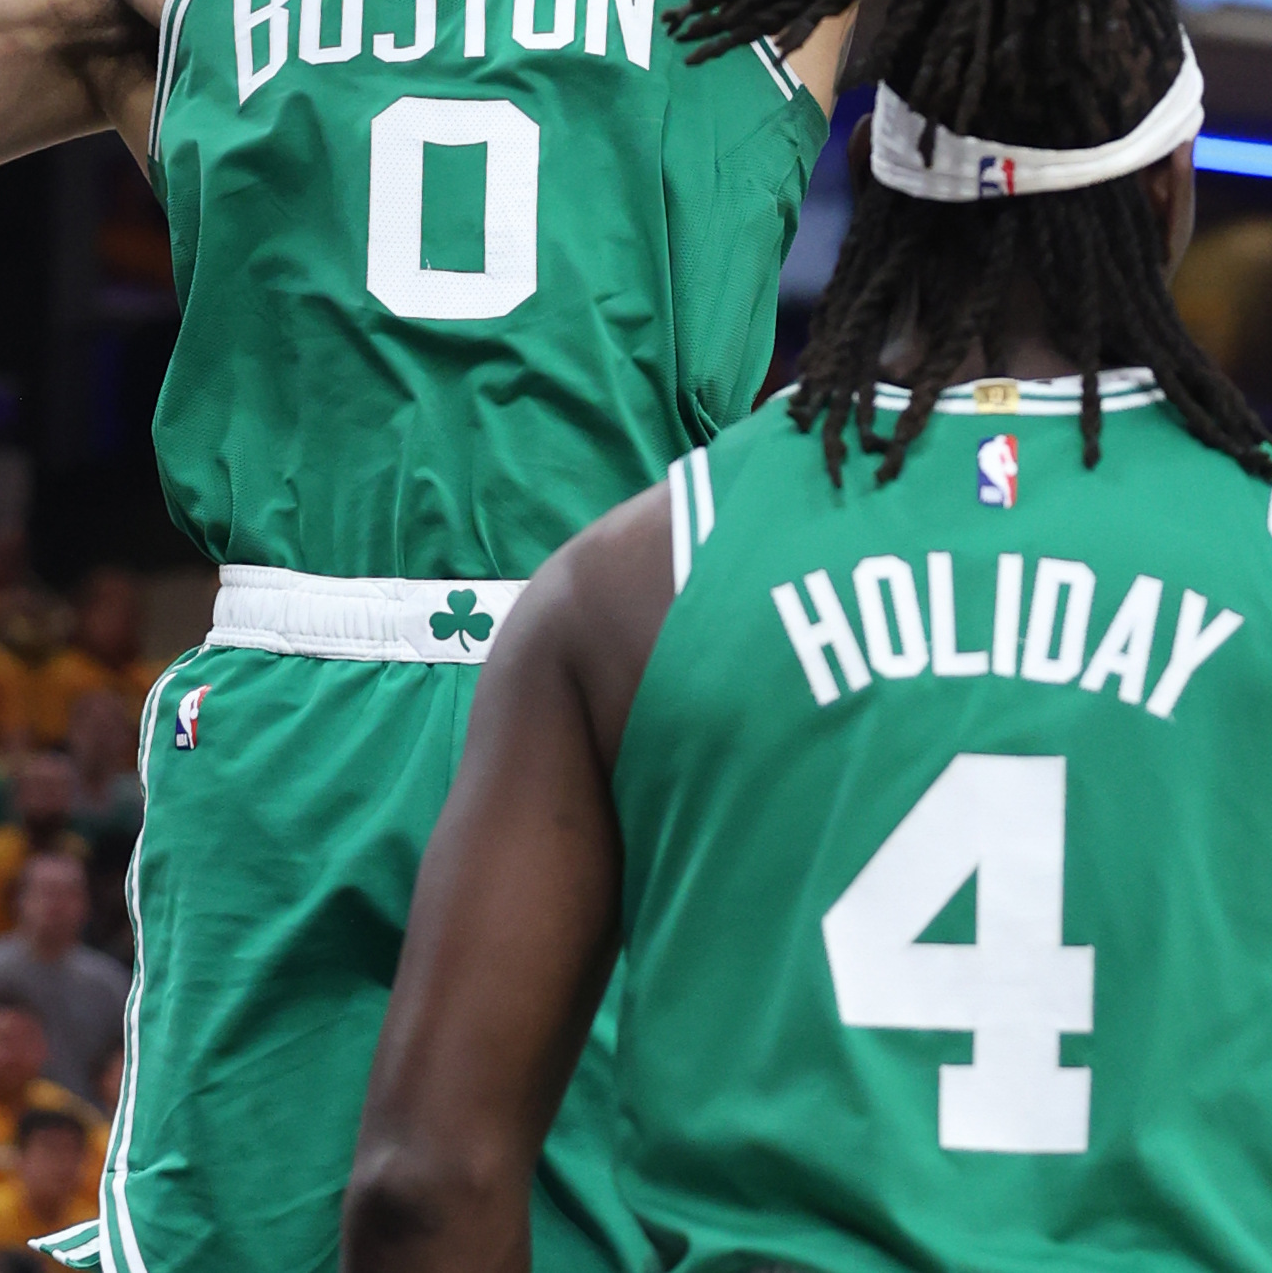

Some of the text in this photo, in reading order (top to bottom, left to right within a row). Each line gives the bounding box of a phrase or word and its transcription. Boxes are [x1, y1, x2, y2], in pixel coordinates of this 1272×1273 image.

[366, 95, 541, 321] 0
[769, 551, 1245, 719] HOLIDAY
[821, 752, 1096, 1154] 4
